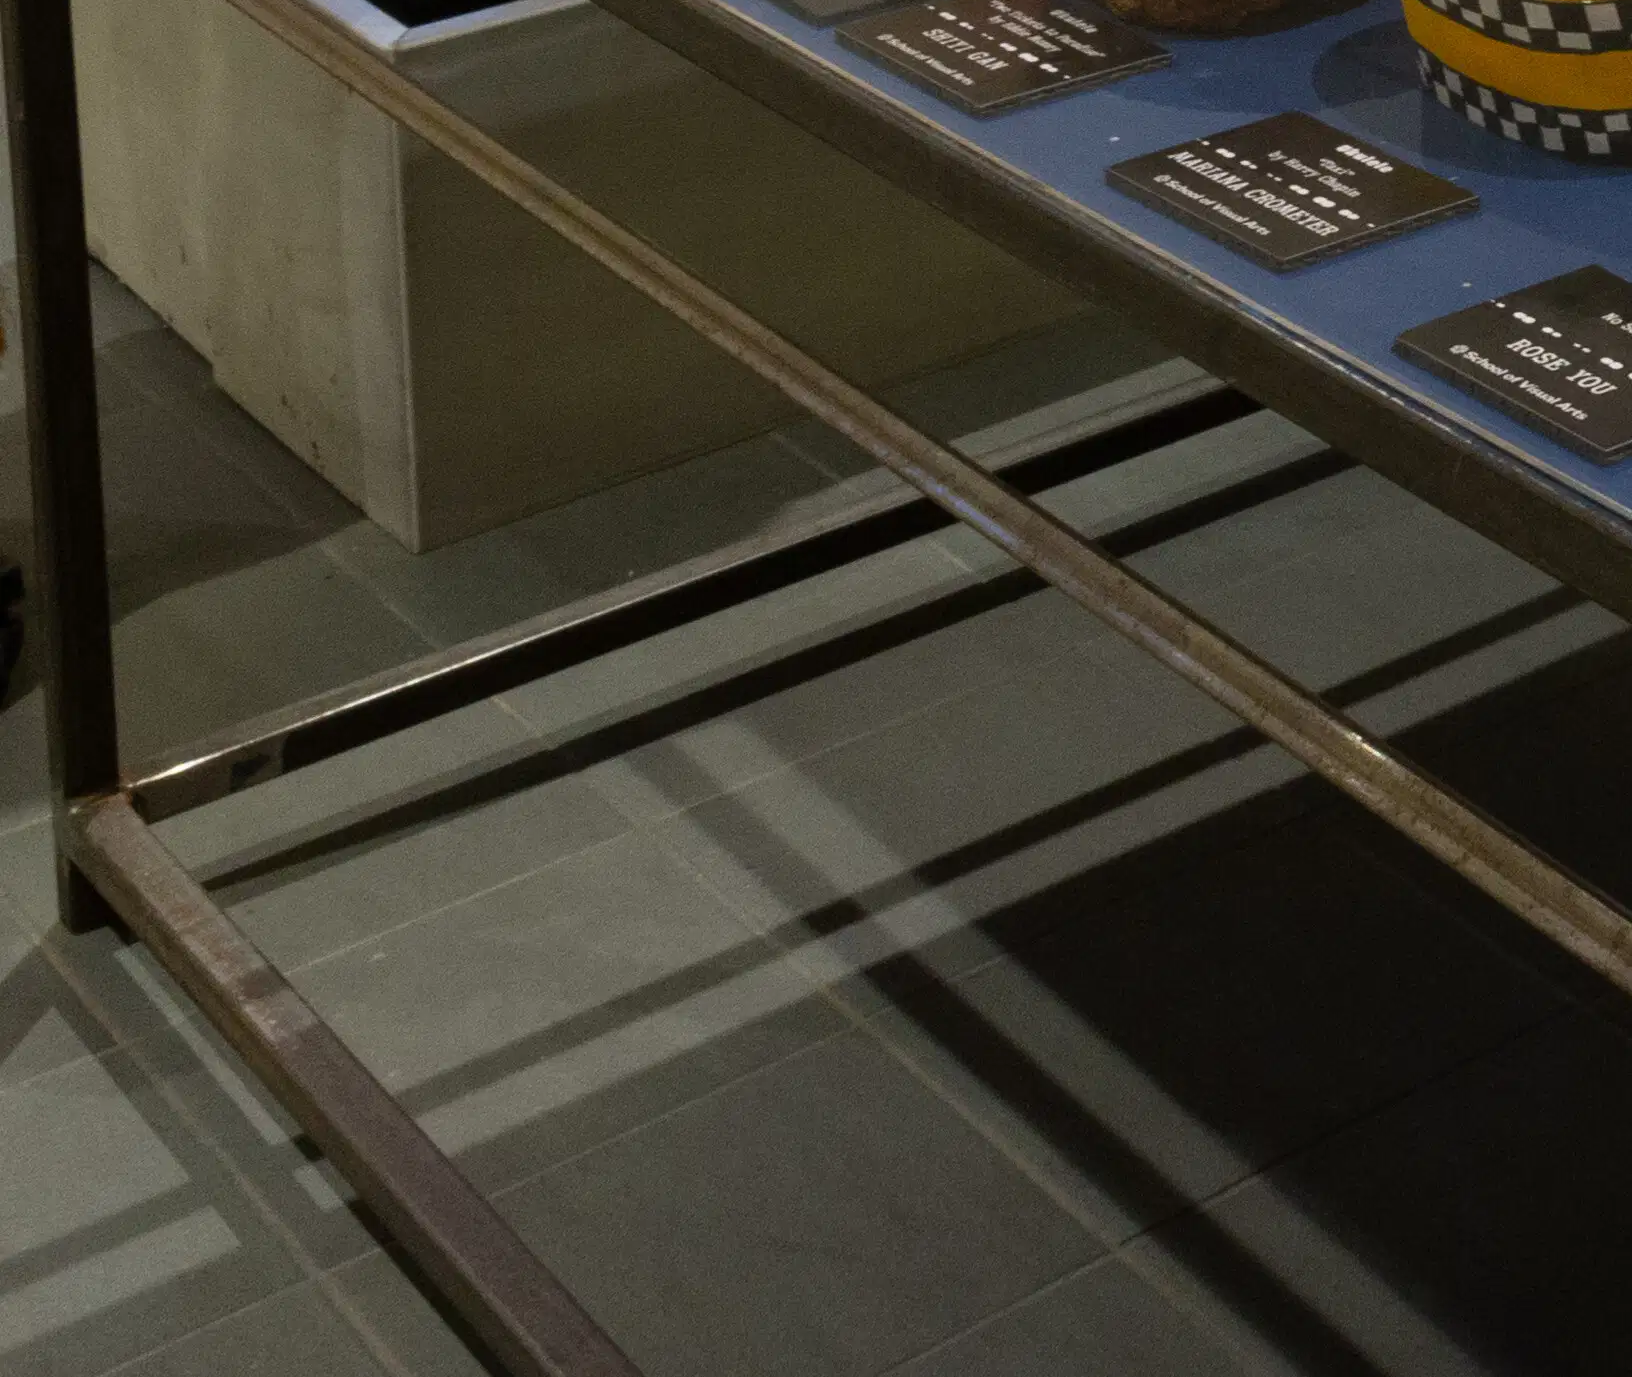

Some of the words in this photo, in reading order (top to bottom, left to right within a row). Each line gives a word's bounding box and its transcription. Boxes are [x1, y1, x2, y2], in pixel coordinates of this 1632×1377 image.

[1168, 151, 1249, 192] MARIANA
[1601, 312, 1623, 325] No
[1463, 351, 1509, 376] School
[1502, 373, 1524, 383] of
[1519, 380, 1562, 405] Visual
[1555, 402, 1588, 421] Arts
[1506, 338, 1571, 371] ROSE
[1566, 369, 1617, 395] YOU
